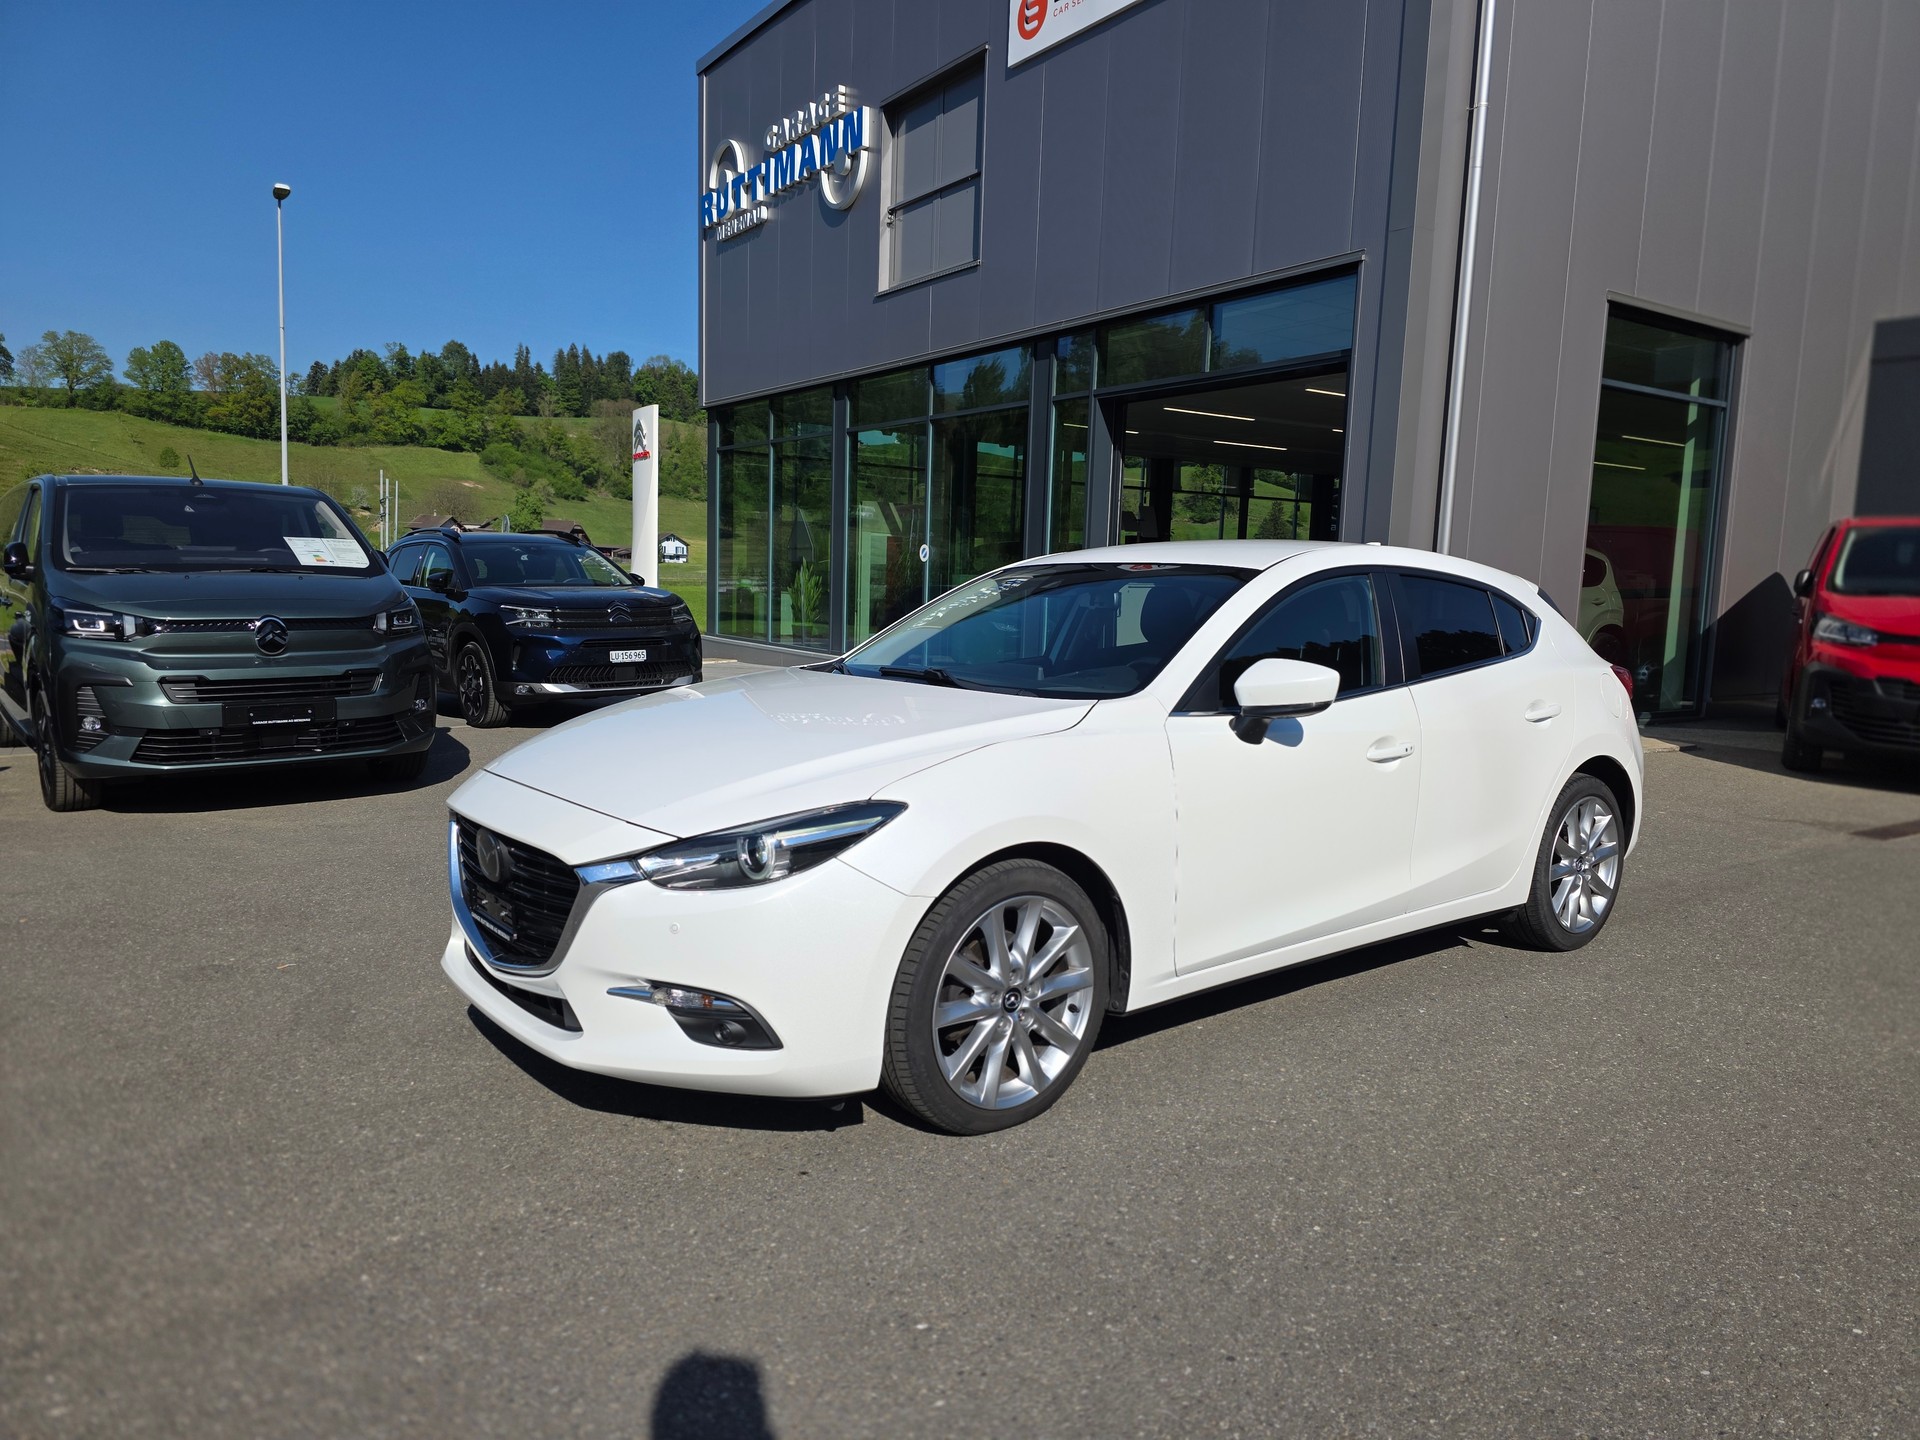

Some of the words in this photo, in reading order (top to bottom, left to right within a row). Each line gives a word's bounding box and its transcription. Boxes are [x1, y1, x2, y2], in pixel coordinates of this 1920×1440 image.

[1053, 2, 1069, 17] CAR
[764, 84, 846, 152] GARAGE
[633, 651, 646, 659] 965
